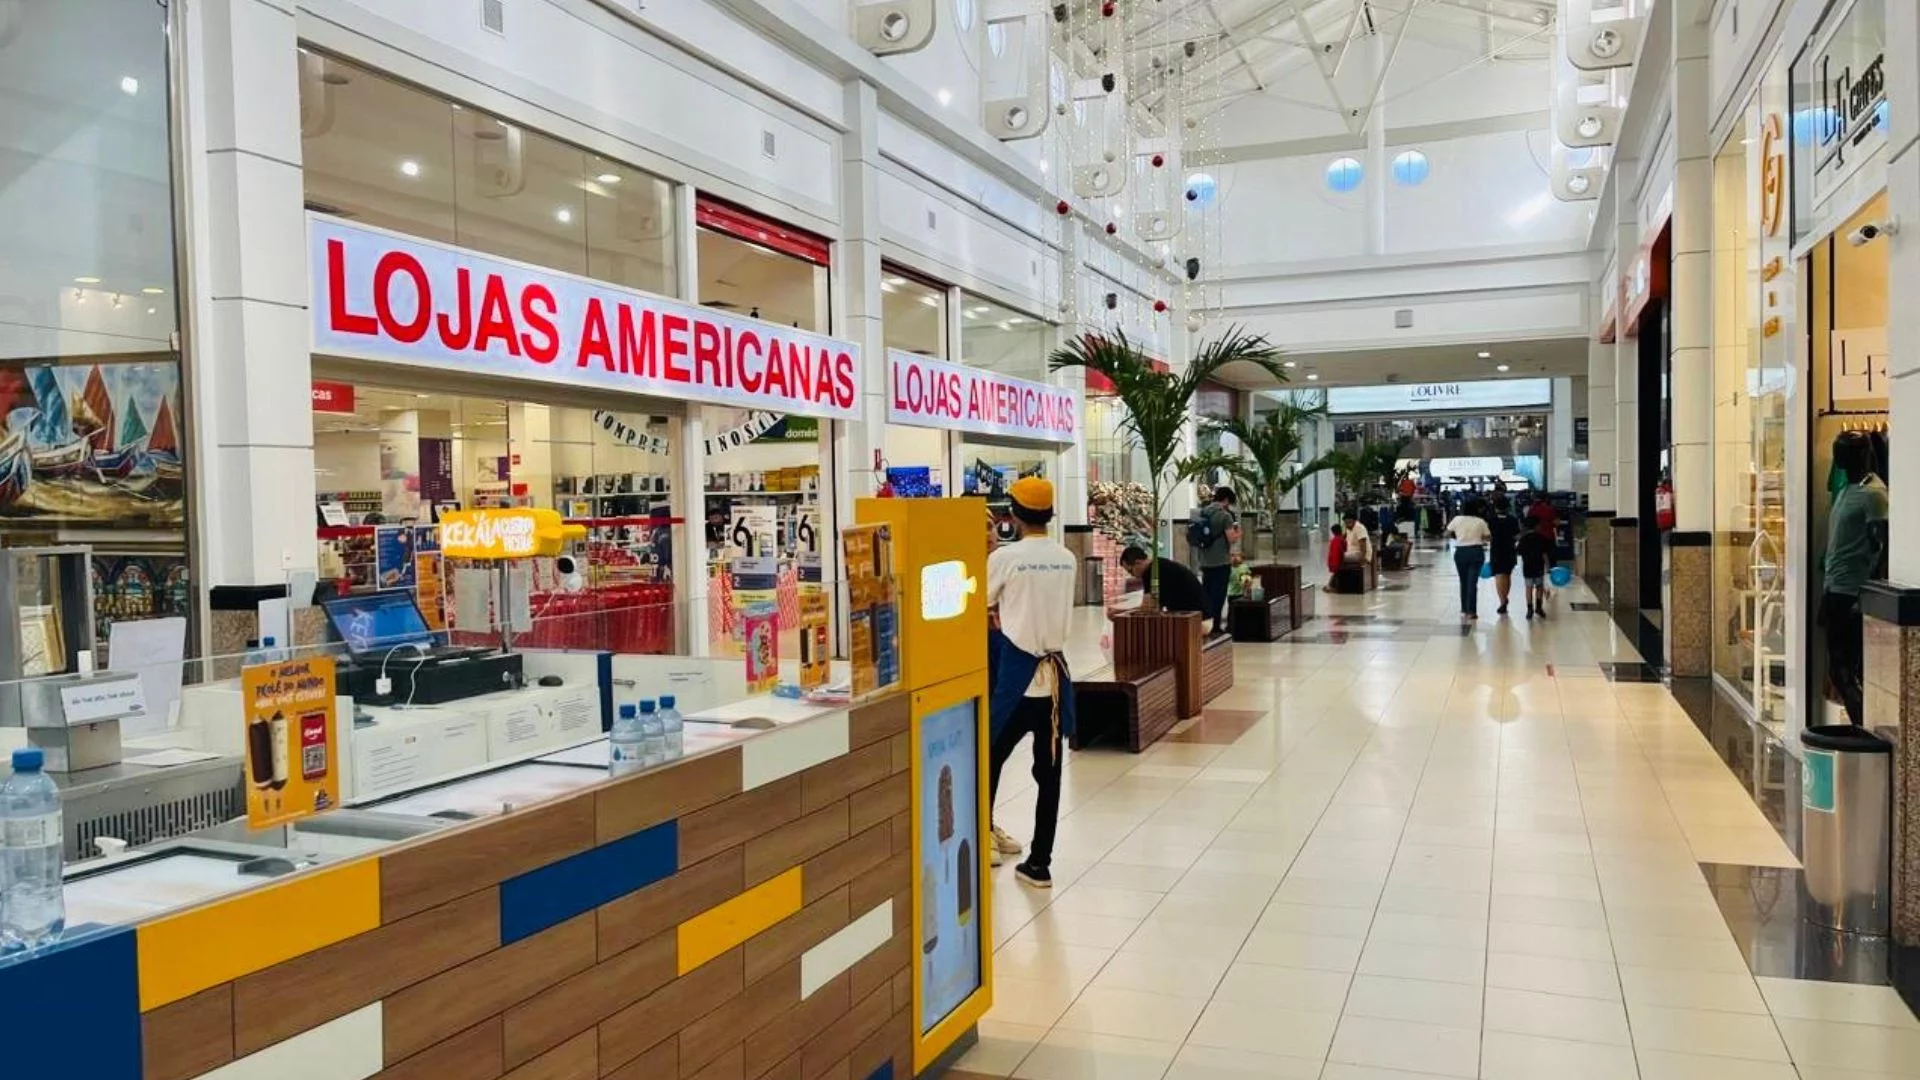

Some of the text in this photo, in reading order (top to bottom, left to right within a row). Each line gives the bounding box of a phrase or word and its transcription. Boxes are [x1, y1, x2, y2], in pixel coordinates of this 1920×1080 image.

[327, 239, 855, 409] LOJAS AMERICANAS
[312, 389, 332, 401] cas
[893, 361, 1076, 433] LOJAS AMERICANAS
